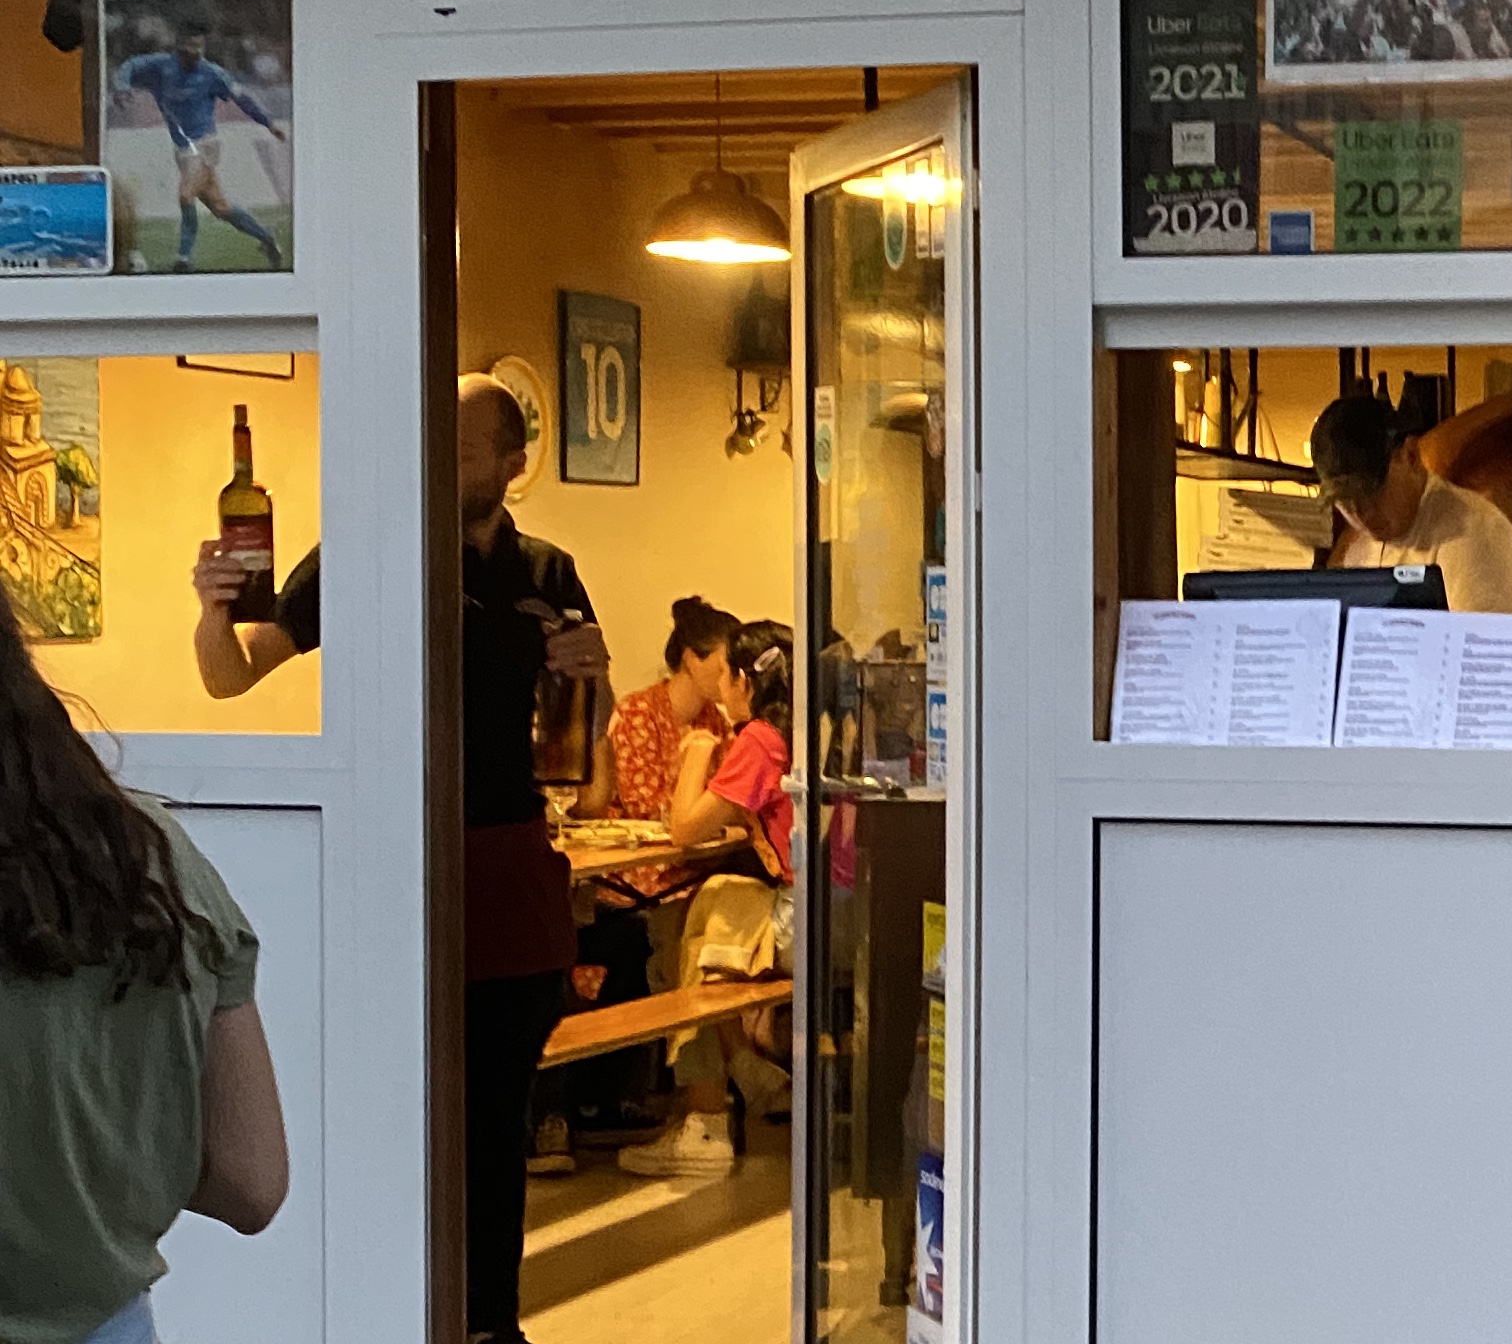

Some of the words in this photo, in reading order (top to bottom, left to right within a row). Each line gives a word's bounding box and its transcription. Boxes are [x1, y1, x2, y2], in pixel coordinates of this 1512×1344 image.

[1148, 62, 1246, 103] 2021
[1145, 196, 1249, 239] 2020
[1343, 178, 1454, 219] 2022
[581, 342, 626, 441] 10
